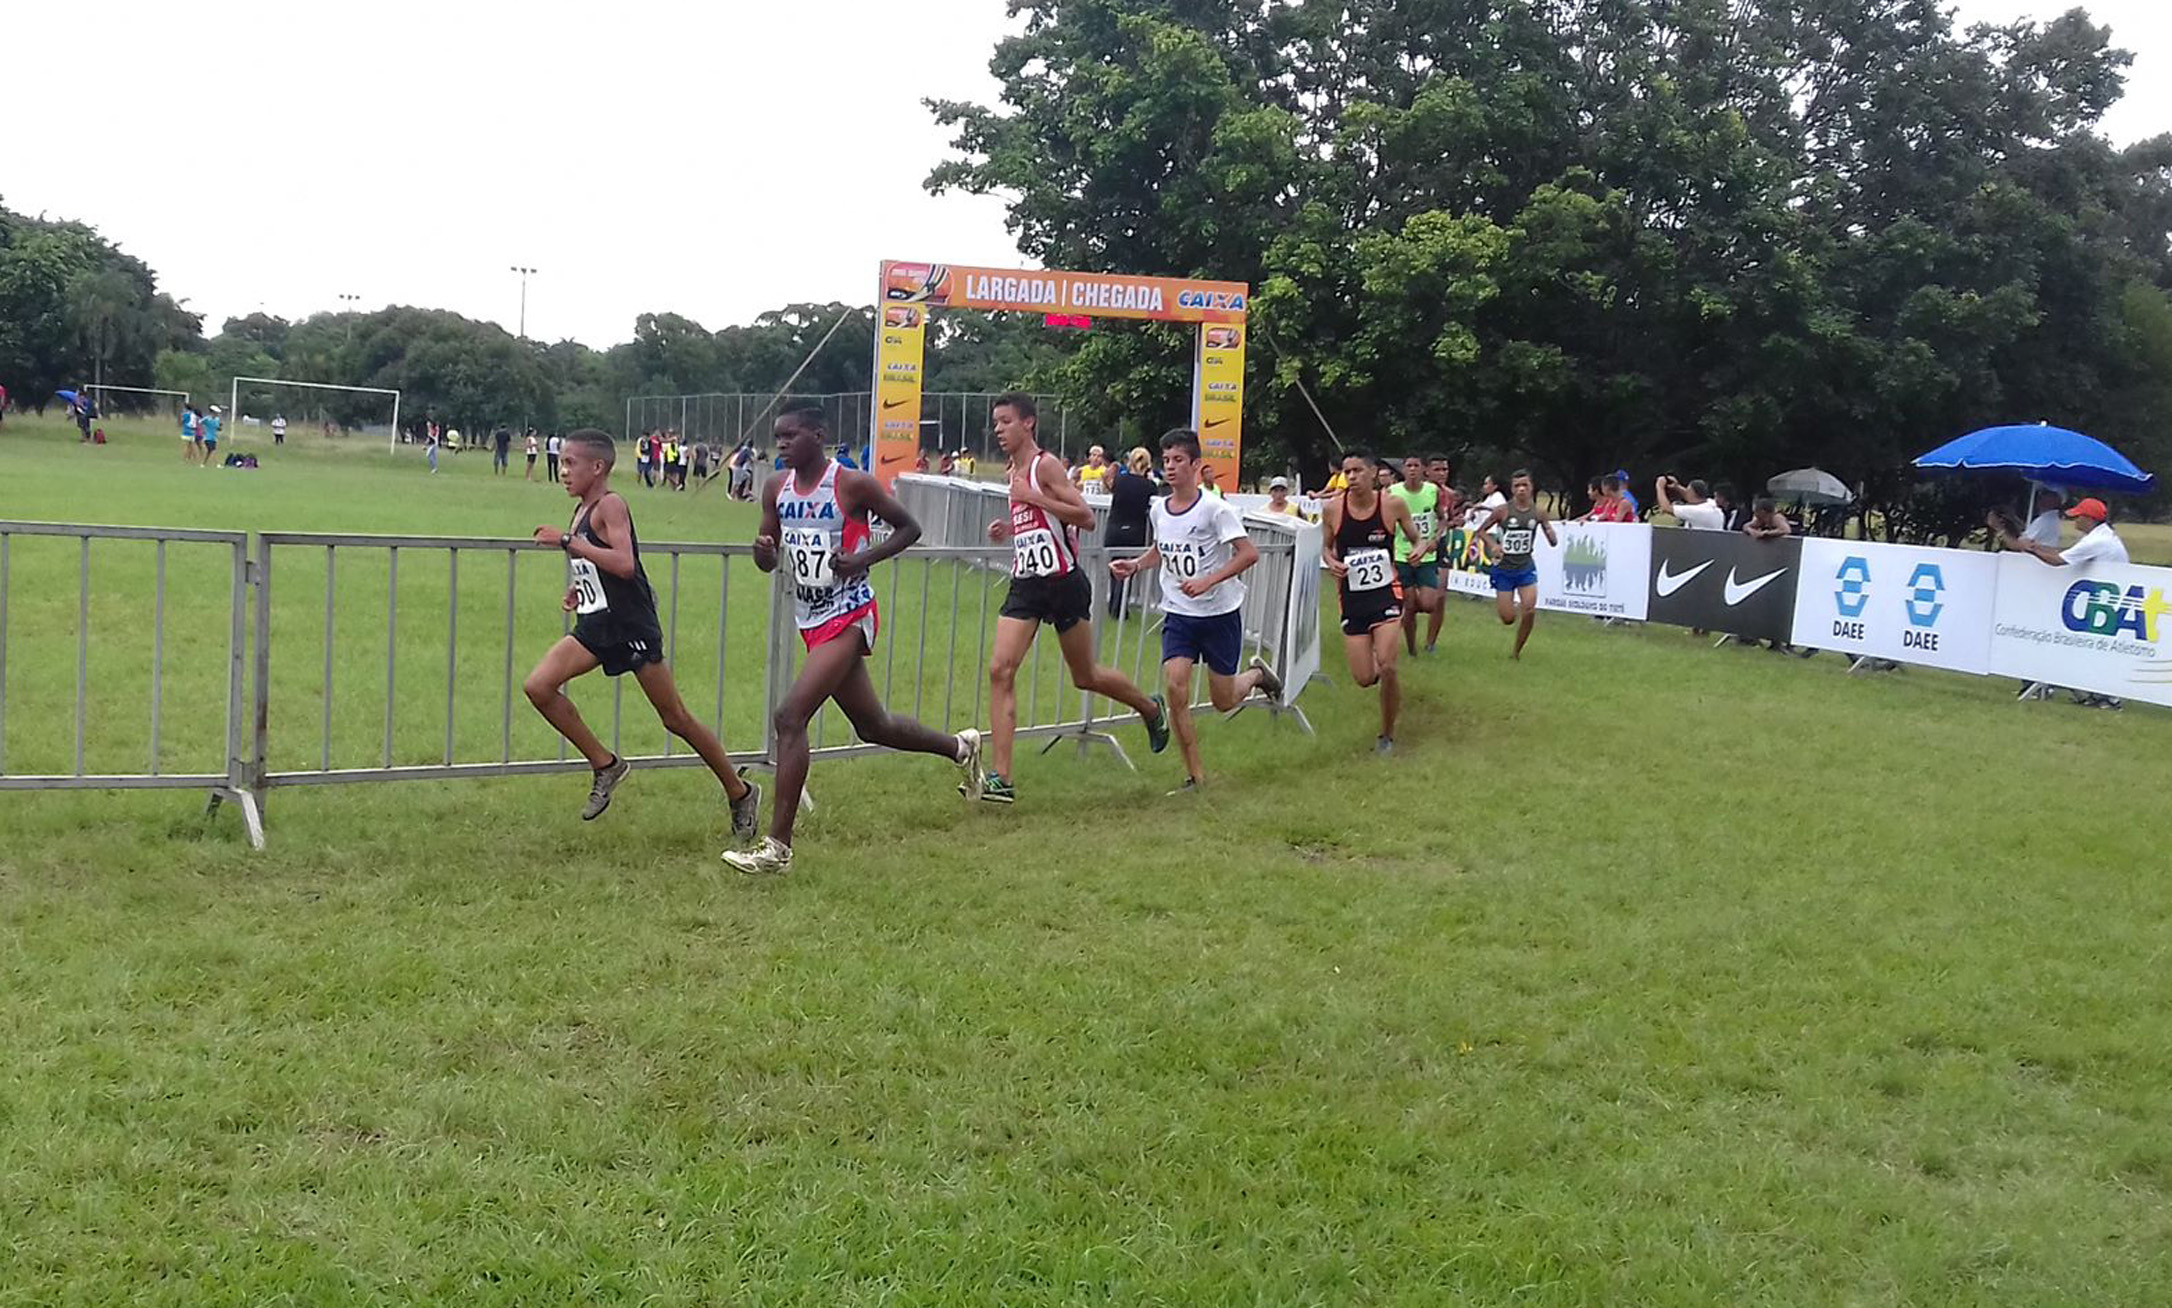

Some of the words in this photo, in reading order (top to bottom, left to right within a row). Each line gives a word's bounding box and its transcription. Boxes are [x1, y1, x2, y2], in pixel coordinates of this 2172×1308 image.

[966, 274, 1056, 304] LARGADA
[1072, 281, 1163, 311] CHEGADA
[1177, 289, 1246, 312] CAIXA
[779, 501, 835, 520] CAIXA
[785, 533, 822, 547] CAIXA
[1159, 542, 1192, 553] CAIXA
[1504, 539, 1530, 552] 305
[1350, 554, 1384, 567] CAIXA
[1357, 565, 1384, 586] 23
[1833, 620, 1864, 640] DAEE
[1903, 630, 1939, 652] DAEE
[2096, 639, 2108, 652] de
